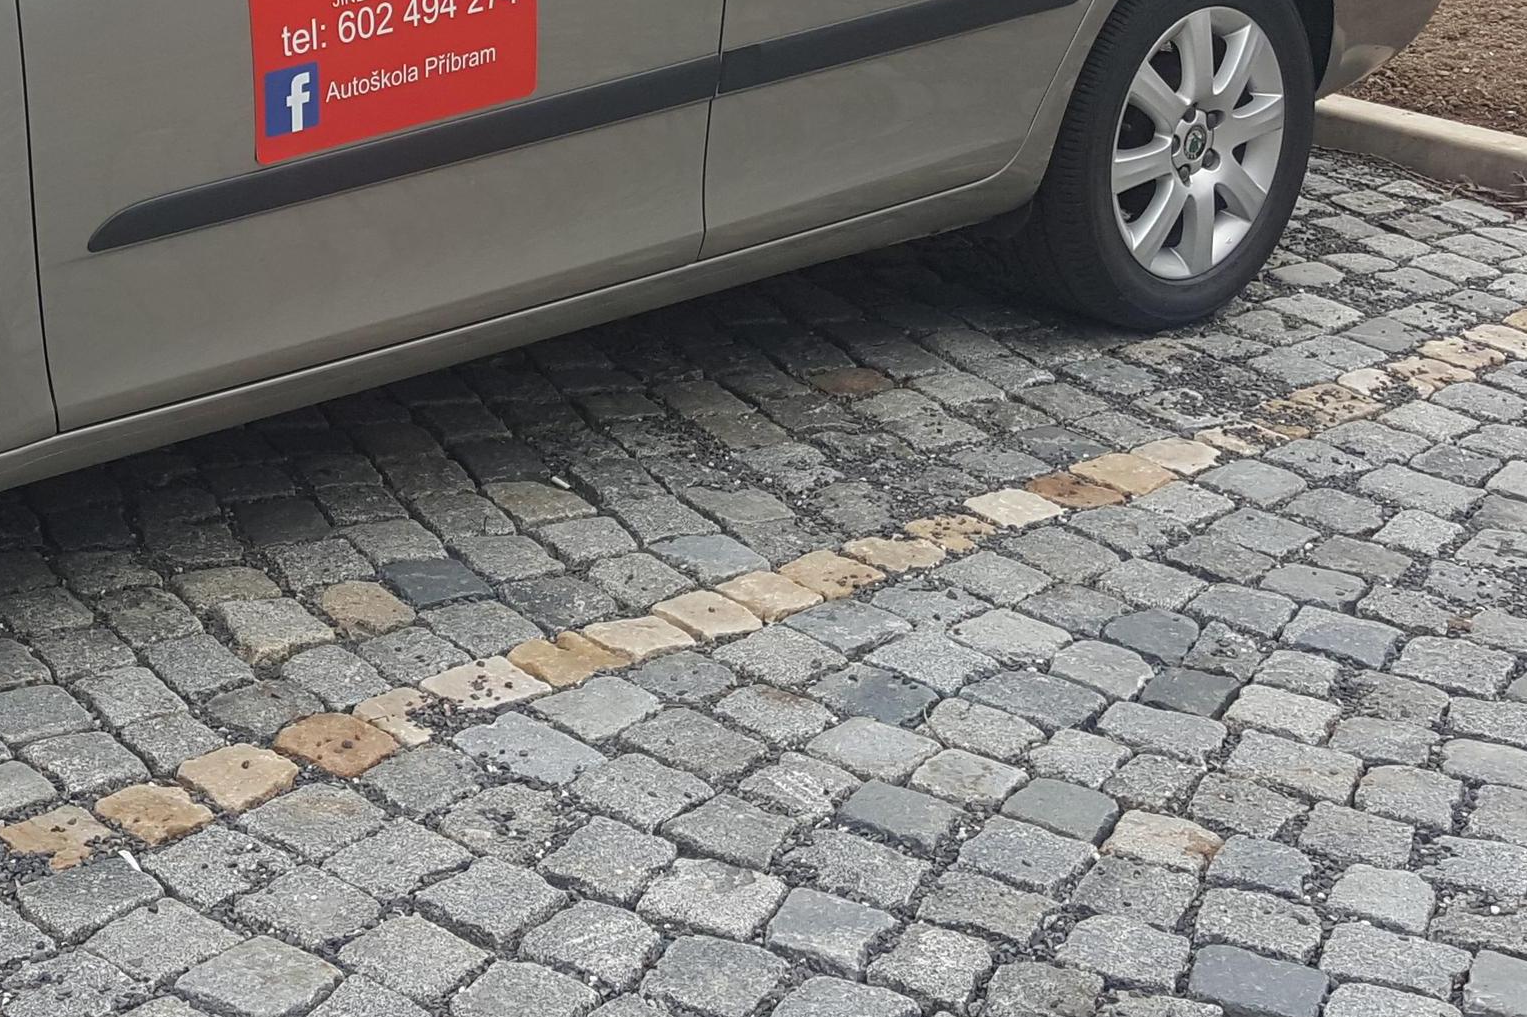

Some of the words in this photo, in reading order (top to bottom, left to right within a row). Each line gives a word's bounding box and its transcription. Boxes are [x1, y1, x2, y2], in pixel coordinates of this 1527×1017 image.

[281, 18, 327, 57] tel:
[338, 2, 393, 43] 602
[325, 64, 419, 103] Autoškola
[425, 46, 496, 79] Příbram
